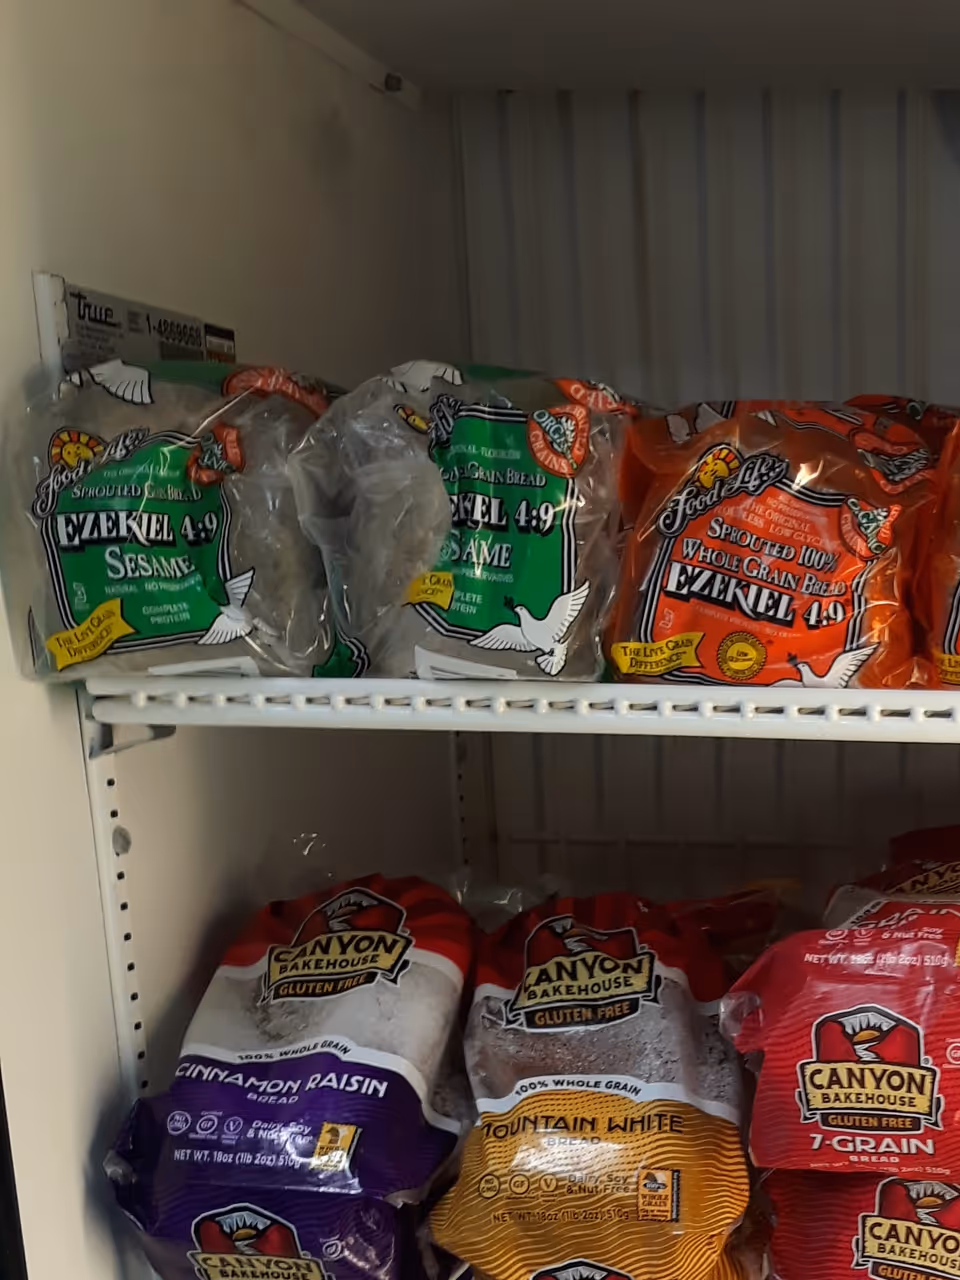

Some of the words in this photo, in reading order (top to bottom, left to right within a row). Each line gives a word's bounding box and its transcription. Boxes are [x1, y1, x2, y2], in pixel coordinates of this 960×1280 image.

[505, 469, 547, 488] BREAD
[71, 483, 141, 498] SPROUTED
[514, 500, 555, 535] 4:9
[56, 511, 174, 548] EZEKIEL
[180, 512, 219, 543] 4:9
[706, 516, 796, 560] SPROUTED
[797, 545, 841, 573] 100%
[104, 545, 196, 581] SESAME
[681, 537, 740, 573] WHOLE
[742, 556, 801, 590] GRAIN
[800, 575, 846, 597] BREAD
[664, 562, 795, 622] EZEKIEL
[802, 601, 846, 626] 4:9
[620, 646, 642, 658] THE
[642, 644, 663, 656] LIVE
[273, 933, 400, 964] CANYON
[279, 953, 380, 975] BAKEHOUSE
[523, 954, 645, 993] CANYON
[279, 981, 334, 997] GLUTEN
[335, 974, 367, 993] FREE
[527, 976, 635, 1001] BAKEHOUSE
[535, 1010, 593, 1026] GLUTEN
[597, 1002, 632, 1018] FREE
[279, 1041, 320, 1059] WHOLE
[319, 1039, 352, 1056] GRAIN
[174, 1062, 303, 1094] CINNAMON
[304, 1072, 389, 1098] RAISIN
[515, 1079, 549, 1097] 100%
[552, 1078, 601, 1089] WHOLE
[604, 1080, 644, 1097] GRAIN
[808, 1066, 927, 1097] CANYON
[820, 1091, 918, 1108] BAKEHOUSE
[607, 1113, 685, 1135] WHITE
[828, 1113, 878, 1128] GLUTEN
[880, 1116, 913, 1129] FREE
[546, 1136, 602, 1147] BREAD
[808, 1134, 935, 1155] 7-GRAIN
[173, 1150, 191, 1162] NET
[193, 1150, 211, 1163] WT.
[212, 1151, 233, 1164] 18oz
[254, 1153, 277, 1167] 2oz)
[849, 1155, 900, 1164] BREAD
[200, 1256, 314, 1274] CANYON
